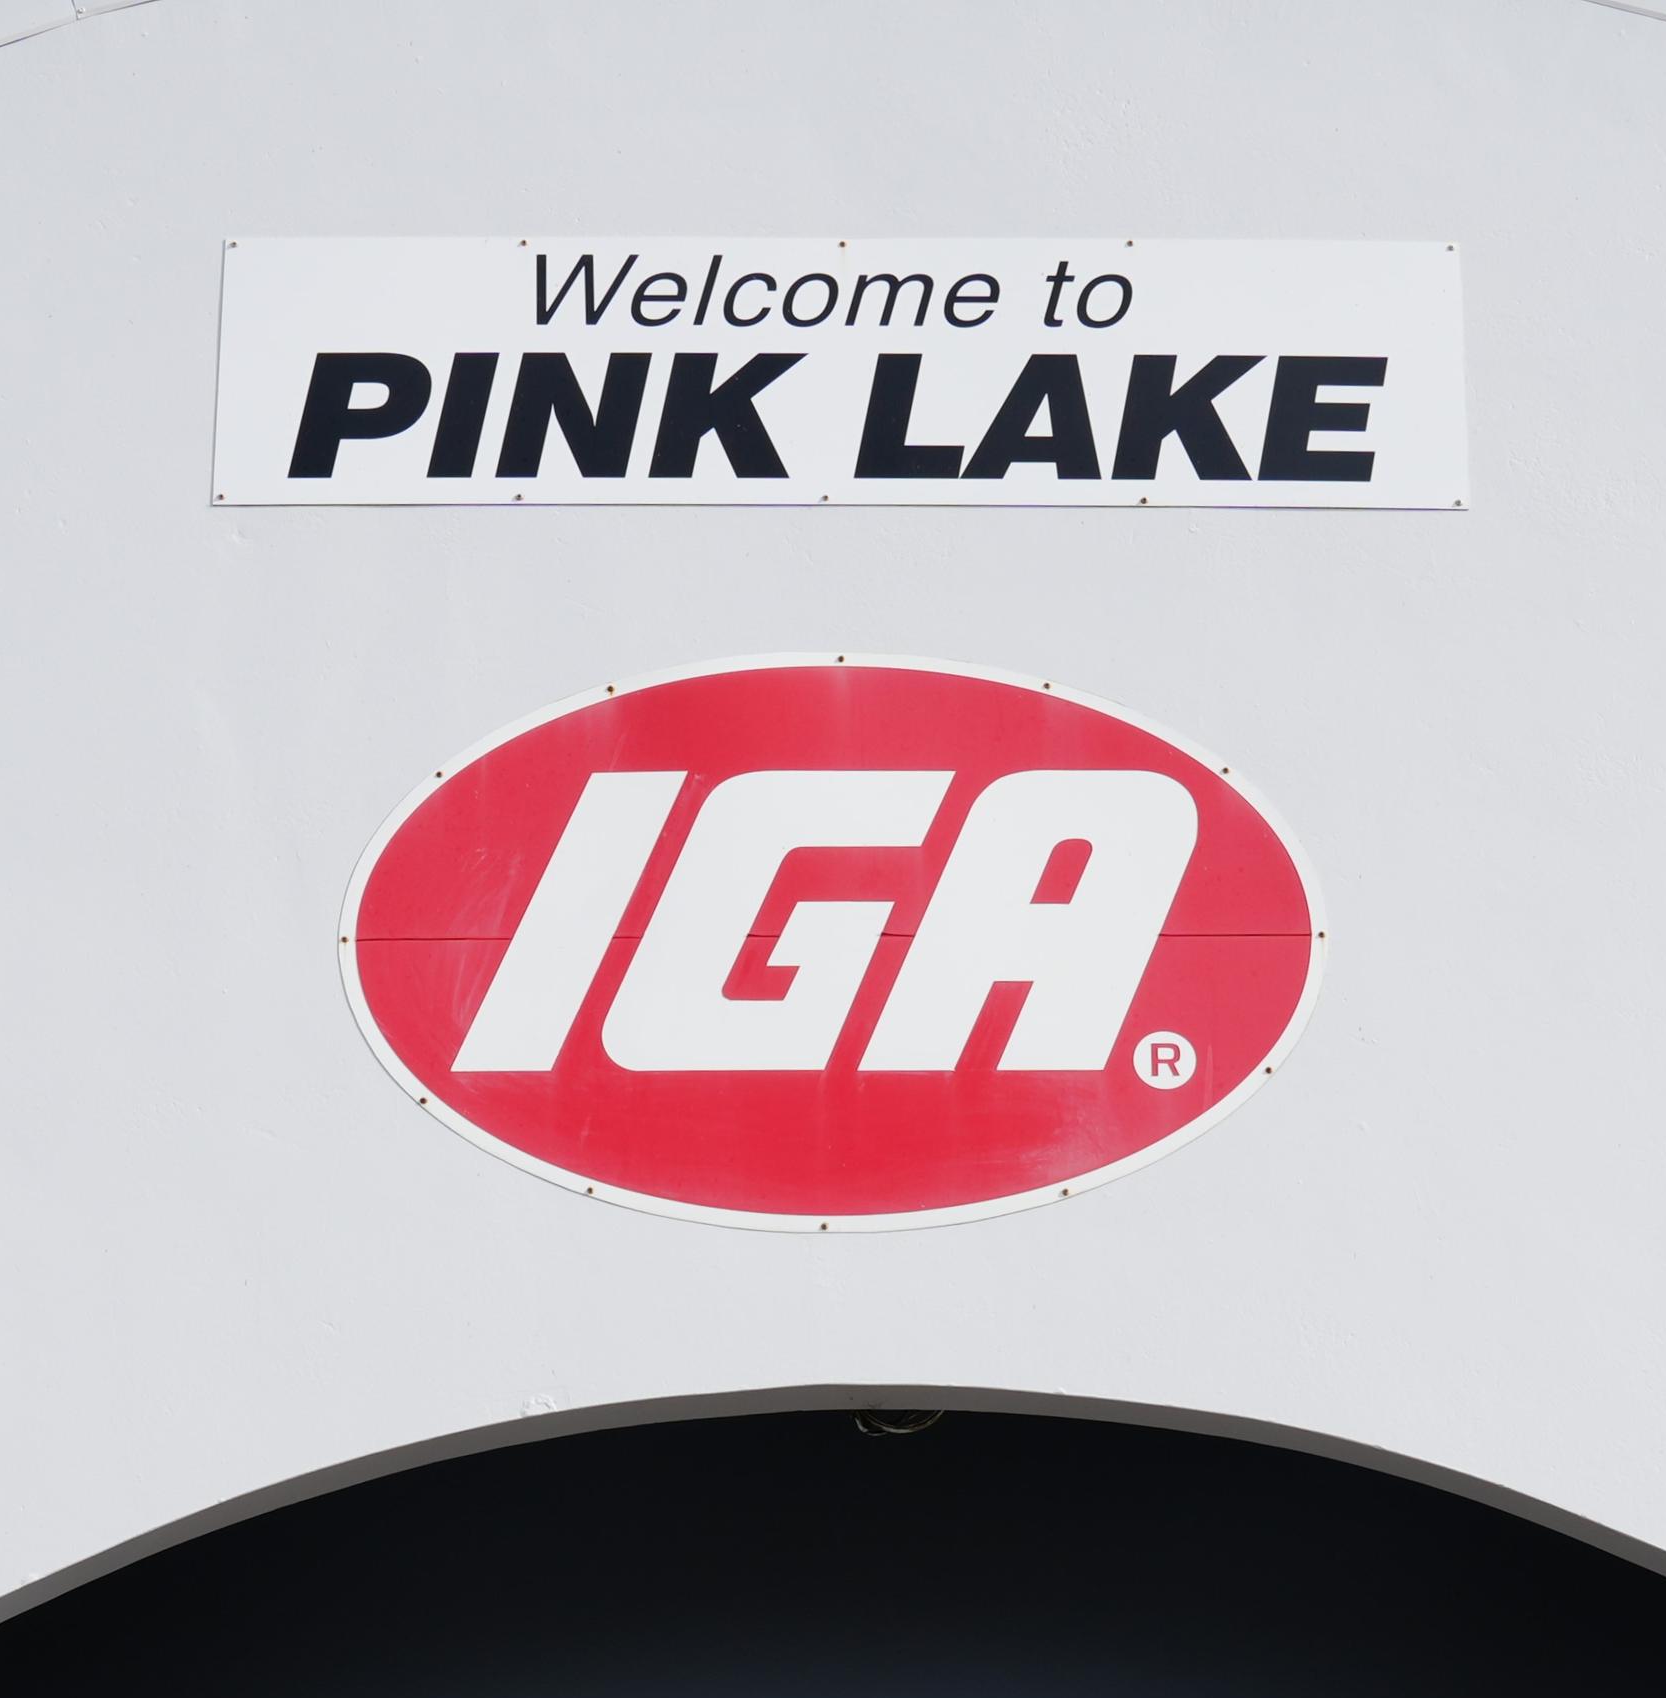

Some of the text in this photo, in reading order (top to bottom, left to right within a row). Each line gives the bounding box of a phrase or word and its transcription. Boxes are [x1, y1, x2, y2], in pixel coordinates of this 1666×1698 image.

[533, 253, 1132, 328] Welcome to
[287, 352, 1388, 482] PINK LAKE
[449, 769, 1199, 1072] IGA
